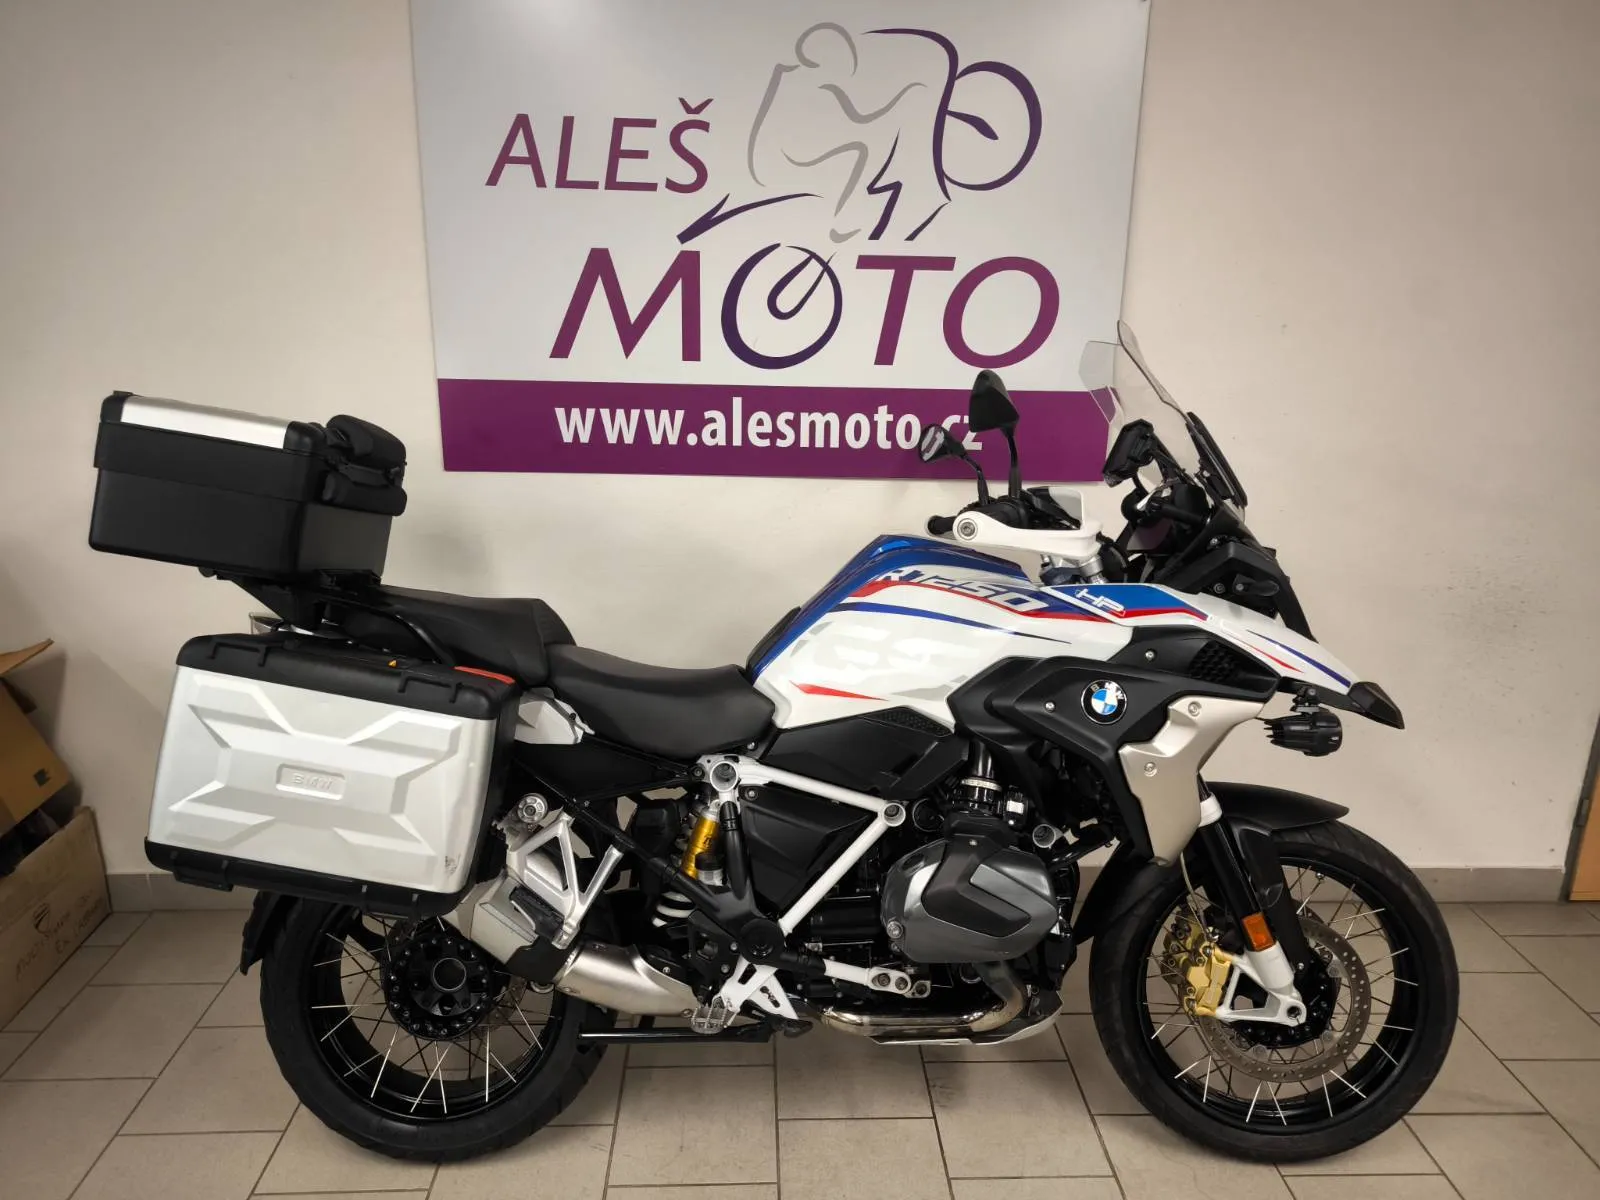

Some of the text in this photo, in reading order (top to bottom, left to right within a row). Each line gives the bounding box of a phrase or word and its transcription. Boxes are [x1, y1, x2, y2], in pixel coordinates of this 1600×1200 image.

[486, 98, 713, 195] ALEŠ
[550, 242, 1061, 370] MOTO
[554, 397, 983, 453] www.alesmotoz
[1074, 588, 1127, 617] HP
